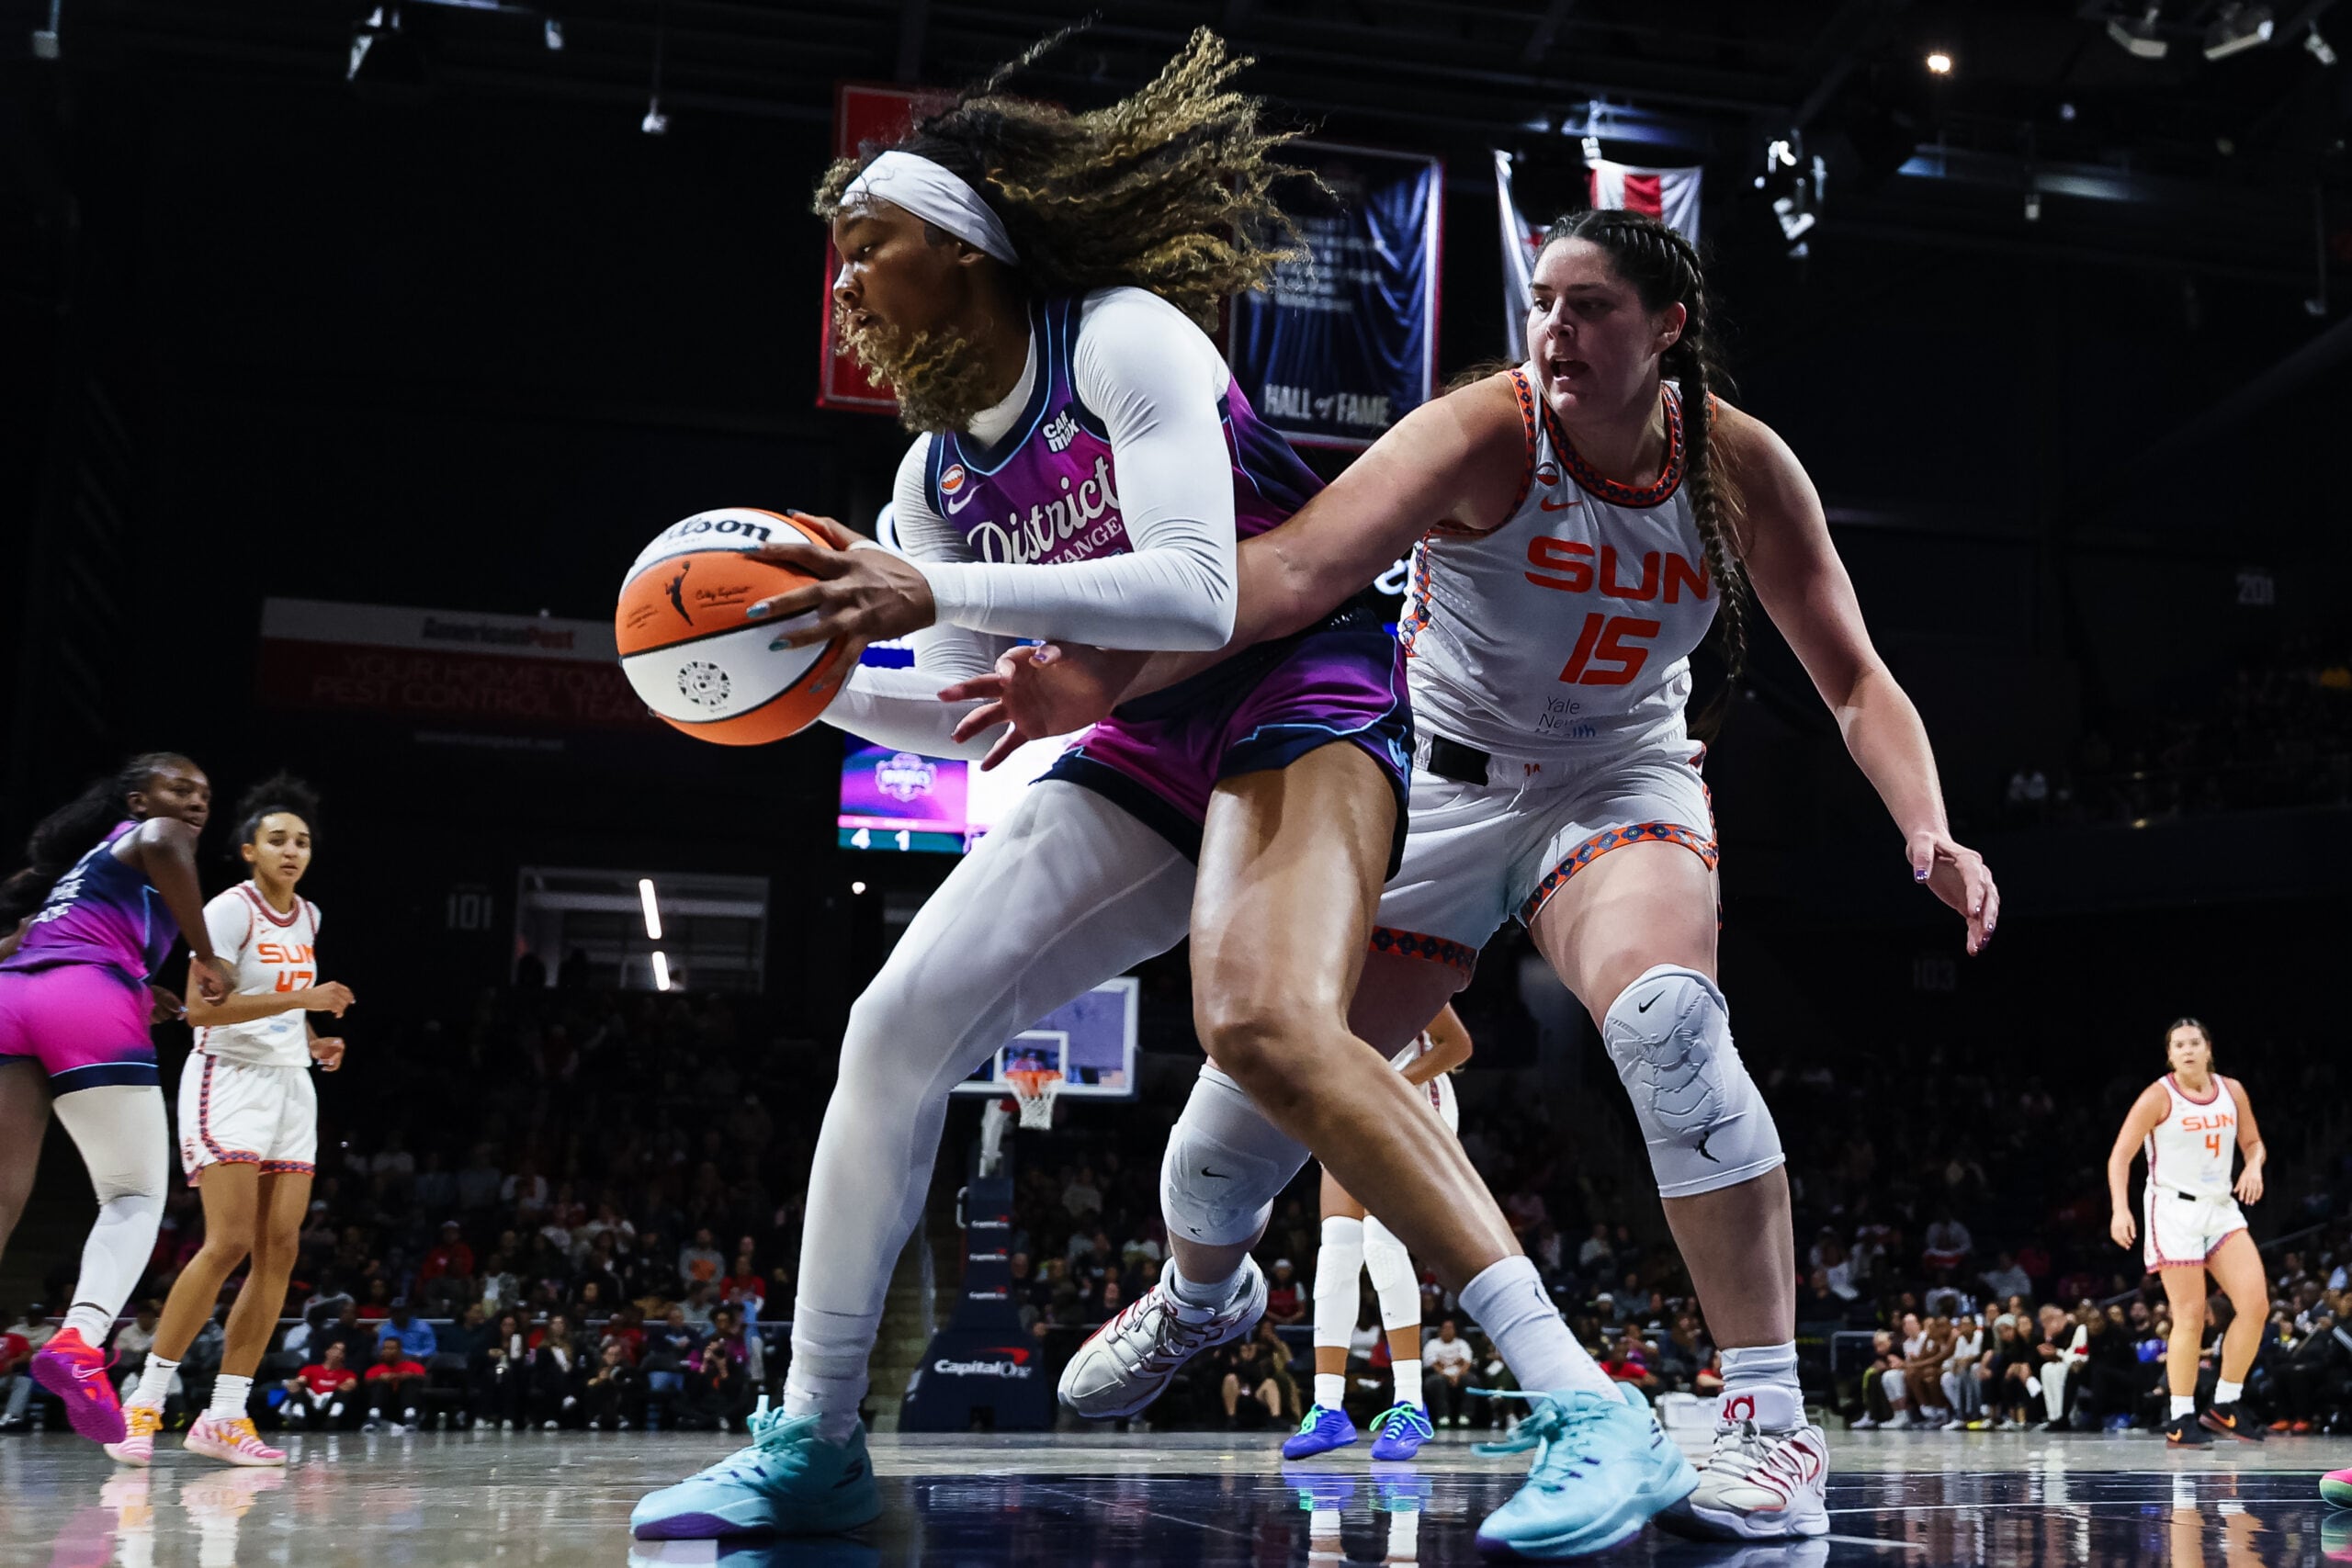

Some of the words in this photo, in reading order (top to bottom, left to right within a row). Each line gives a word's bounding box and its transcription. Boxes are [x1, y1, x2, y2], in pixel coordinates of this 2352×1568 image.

[1264, 383, 1311, 420] HALL
[1337, 392, 1391, 427] FAME
[967, 456, 1122, 564] District
[1524, 536, 1711, 604] SUN
[1558, 613, 1661, 685] 15
[1547, 695, 1580, 715] Yale
[851, 828, 871, 851] 4
[446, 893, 493, 931] 101
[2181, 1113, 2235, 1133] SUN
[2206, 1134, 2220, 1158] 4
